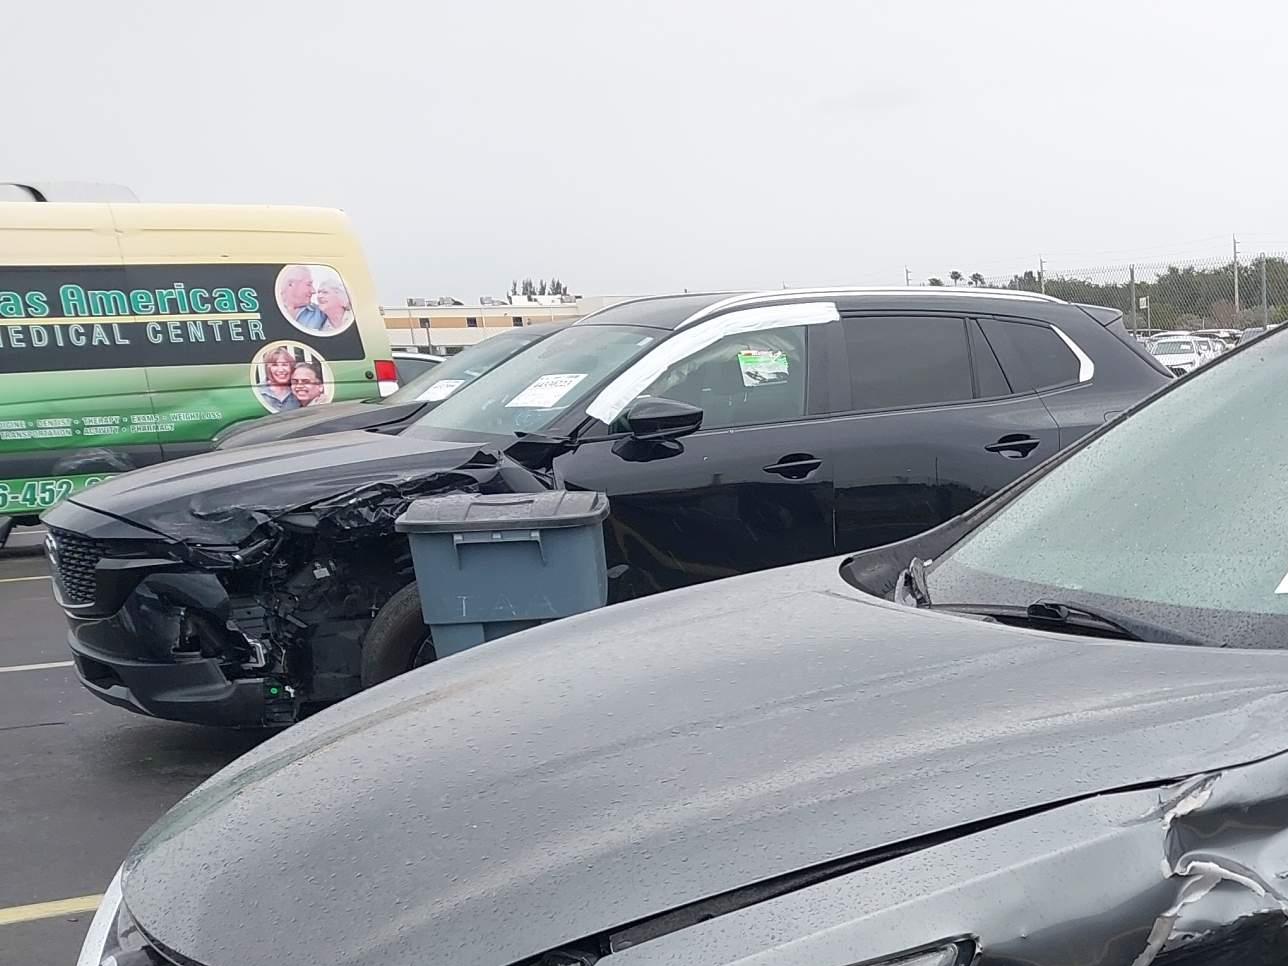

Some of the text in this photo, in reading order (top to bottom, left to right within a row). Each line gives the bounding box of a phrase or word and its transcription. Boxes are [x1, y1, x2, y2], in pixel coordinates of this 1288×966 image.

[59, 282, 259, 316] Americas
[0, 319, 266, 348] EDICAL CENTER
[130, 413, 160, 423] EXAMS
